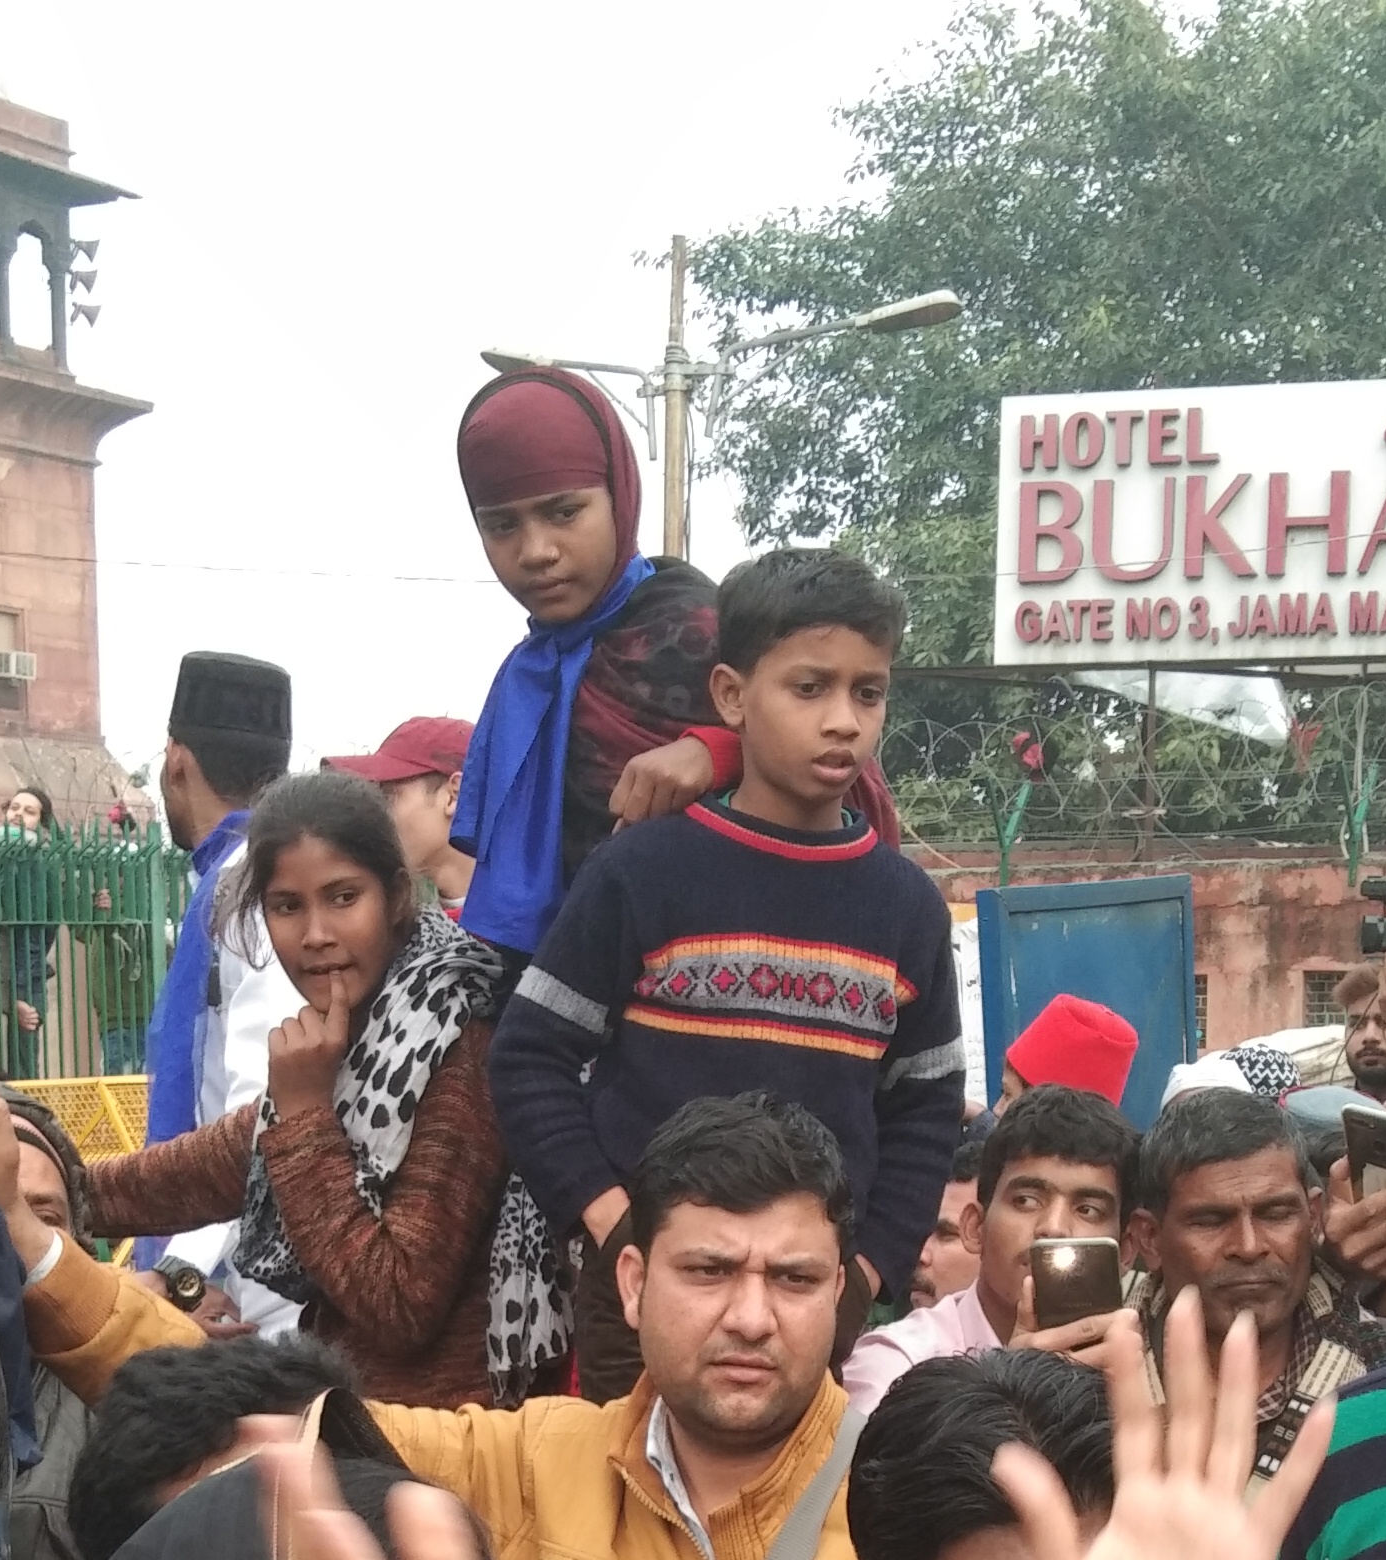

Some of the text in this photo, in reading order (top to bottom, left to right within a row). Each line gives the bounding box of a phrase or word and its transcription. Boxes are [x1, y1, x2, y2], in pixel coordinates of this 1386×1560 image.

[1019, 406, 1220, 470] HOTEL
[1014, 598, 1114, 643] GATE
[1125, 596, 1181, 640] NO
[1227, 590, 1338, 638] JAMA
